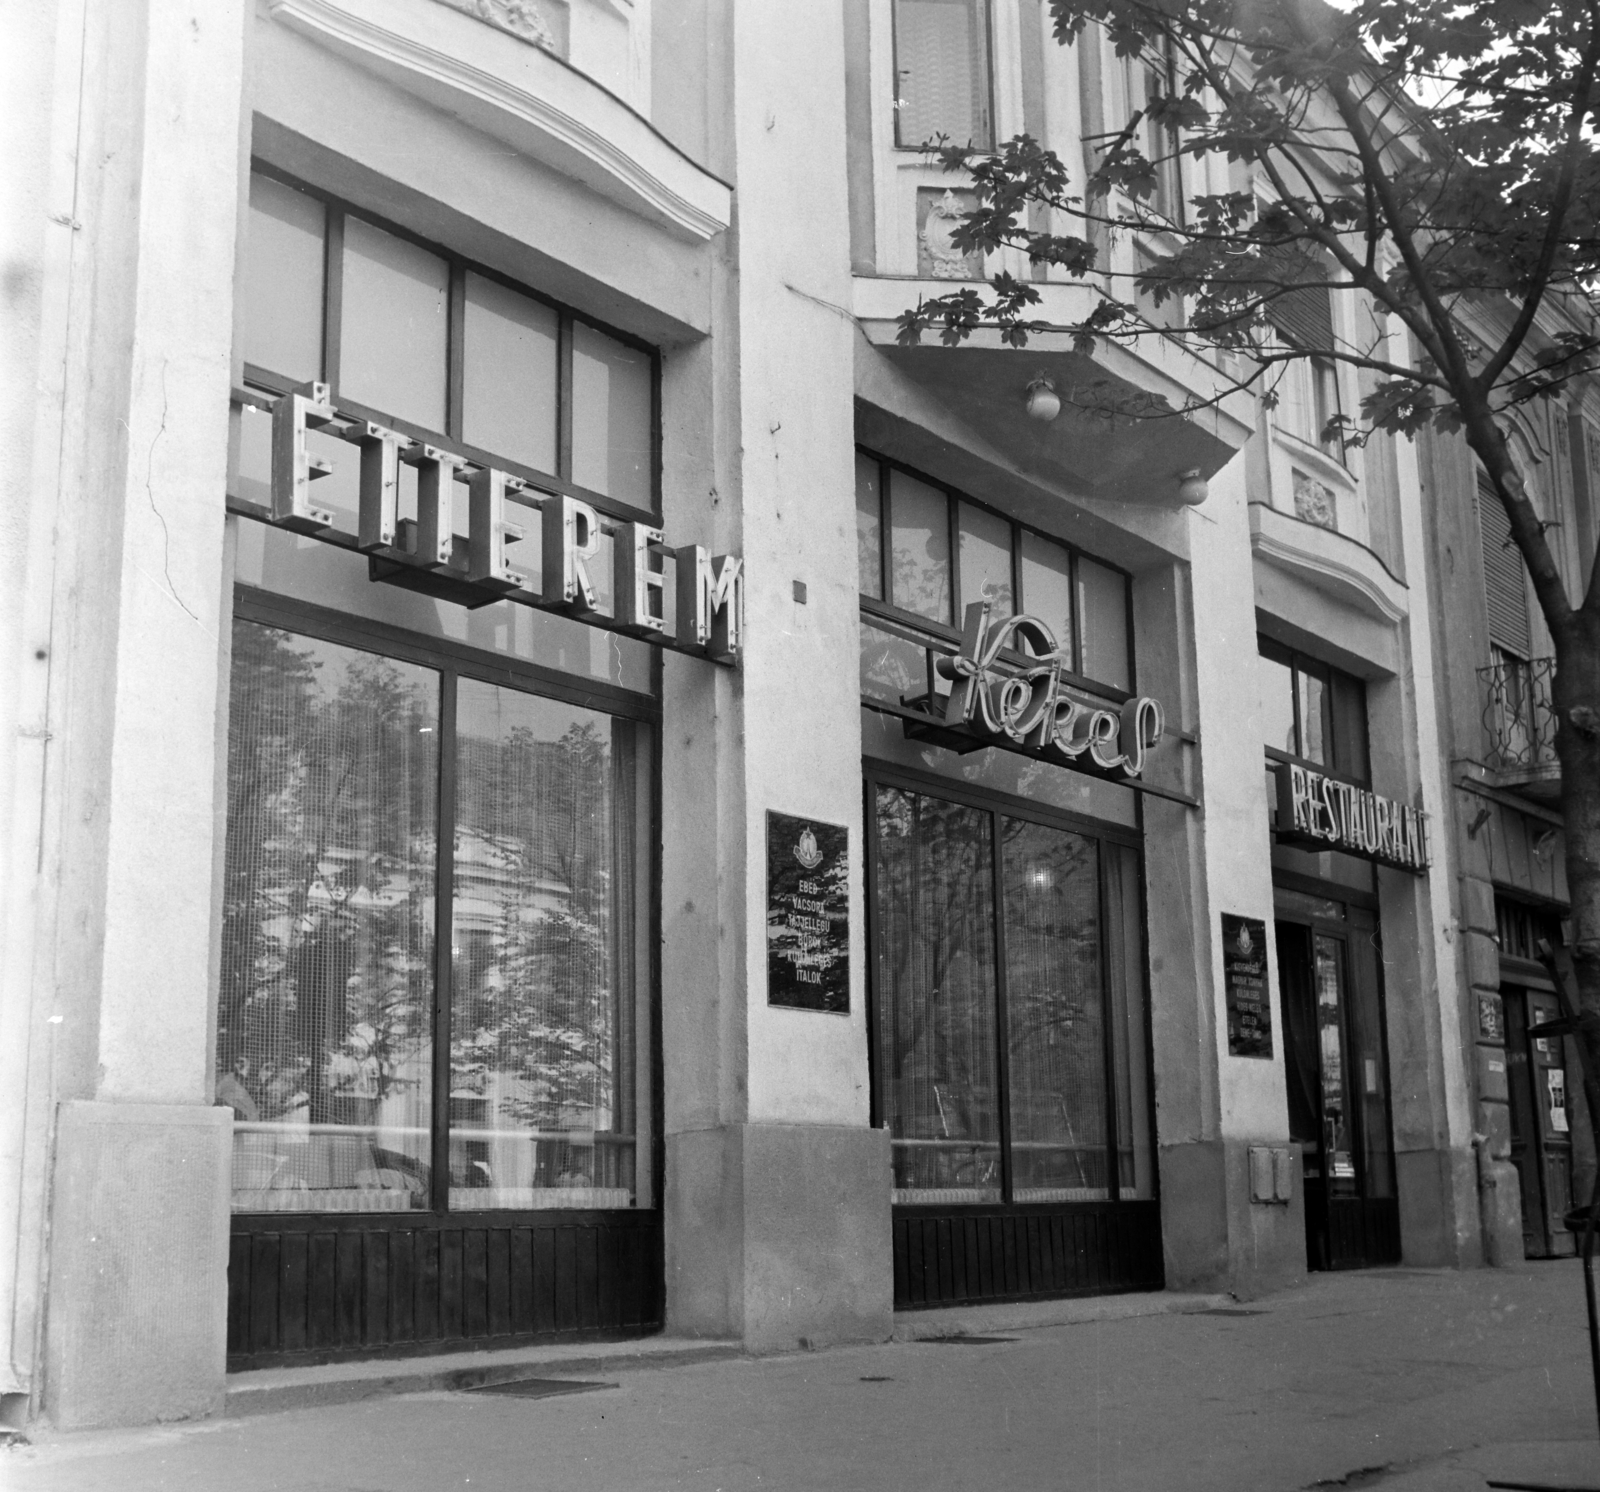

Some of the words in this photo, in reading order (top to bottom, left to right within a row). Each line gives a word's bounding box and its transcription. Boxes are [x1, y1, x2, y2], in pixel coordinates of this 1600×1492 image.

[276, 381, 743, 656] ÉTTEREM
[1289, 763, 1433, 869] RESTAURANT
[793, 896, 825, 914] VACSORA
[796, 969, 822, 985] ITALOK
